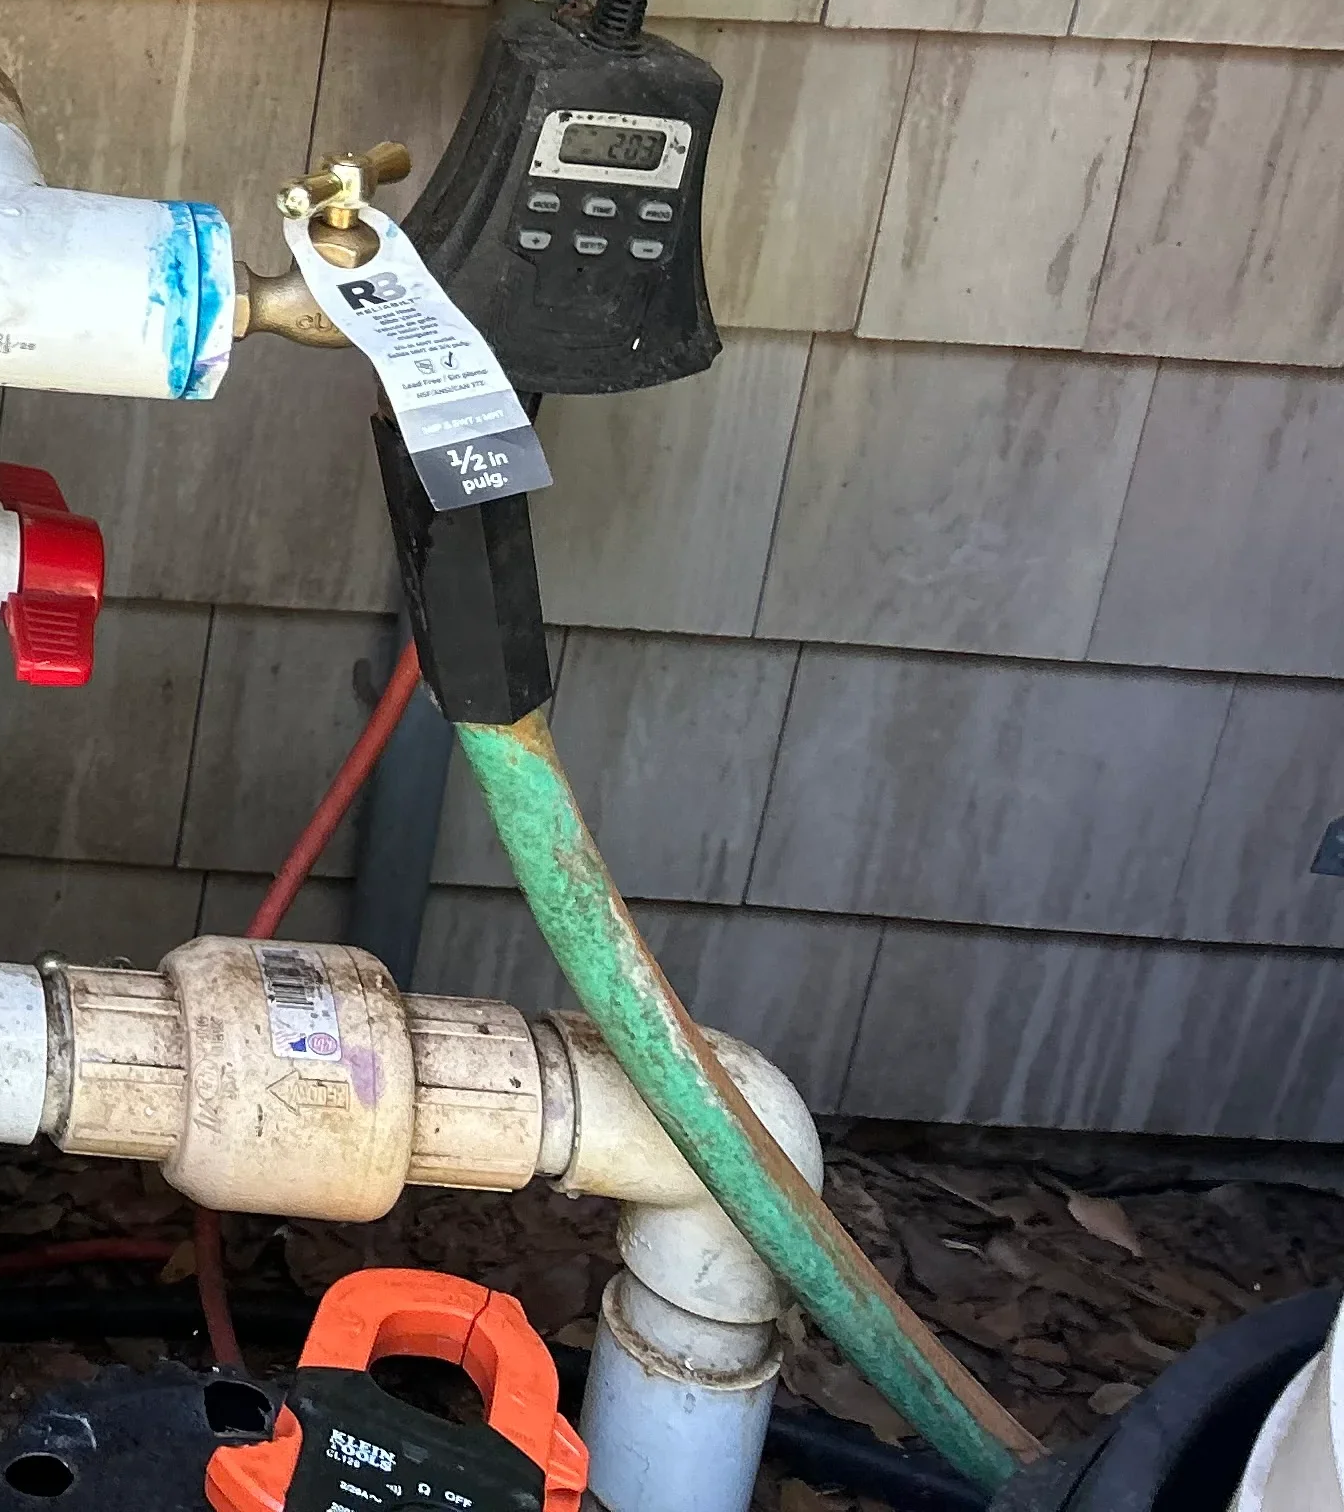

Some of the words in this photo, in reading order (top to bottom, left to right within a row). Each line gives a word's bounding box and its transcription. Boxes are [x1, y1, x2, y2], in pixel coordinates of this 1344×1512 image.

[446, 445, 488, 475] 1/2
[488, 451, 510, 467] in
[461, 471, 509, 495] pulg.
[329, 1437, 394, 1473] TOOLS
[330, 1428, 397, 1465] KLEIN
[444, 1490, 473, 1509] OFF
